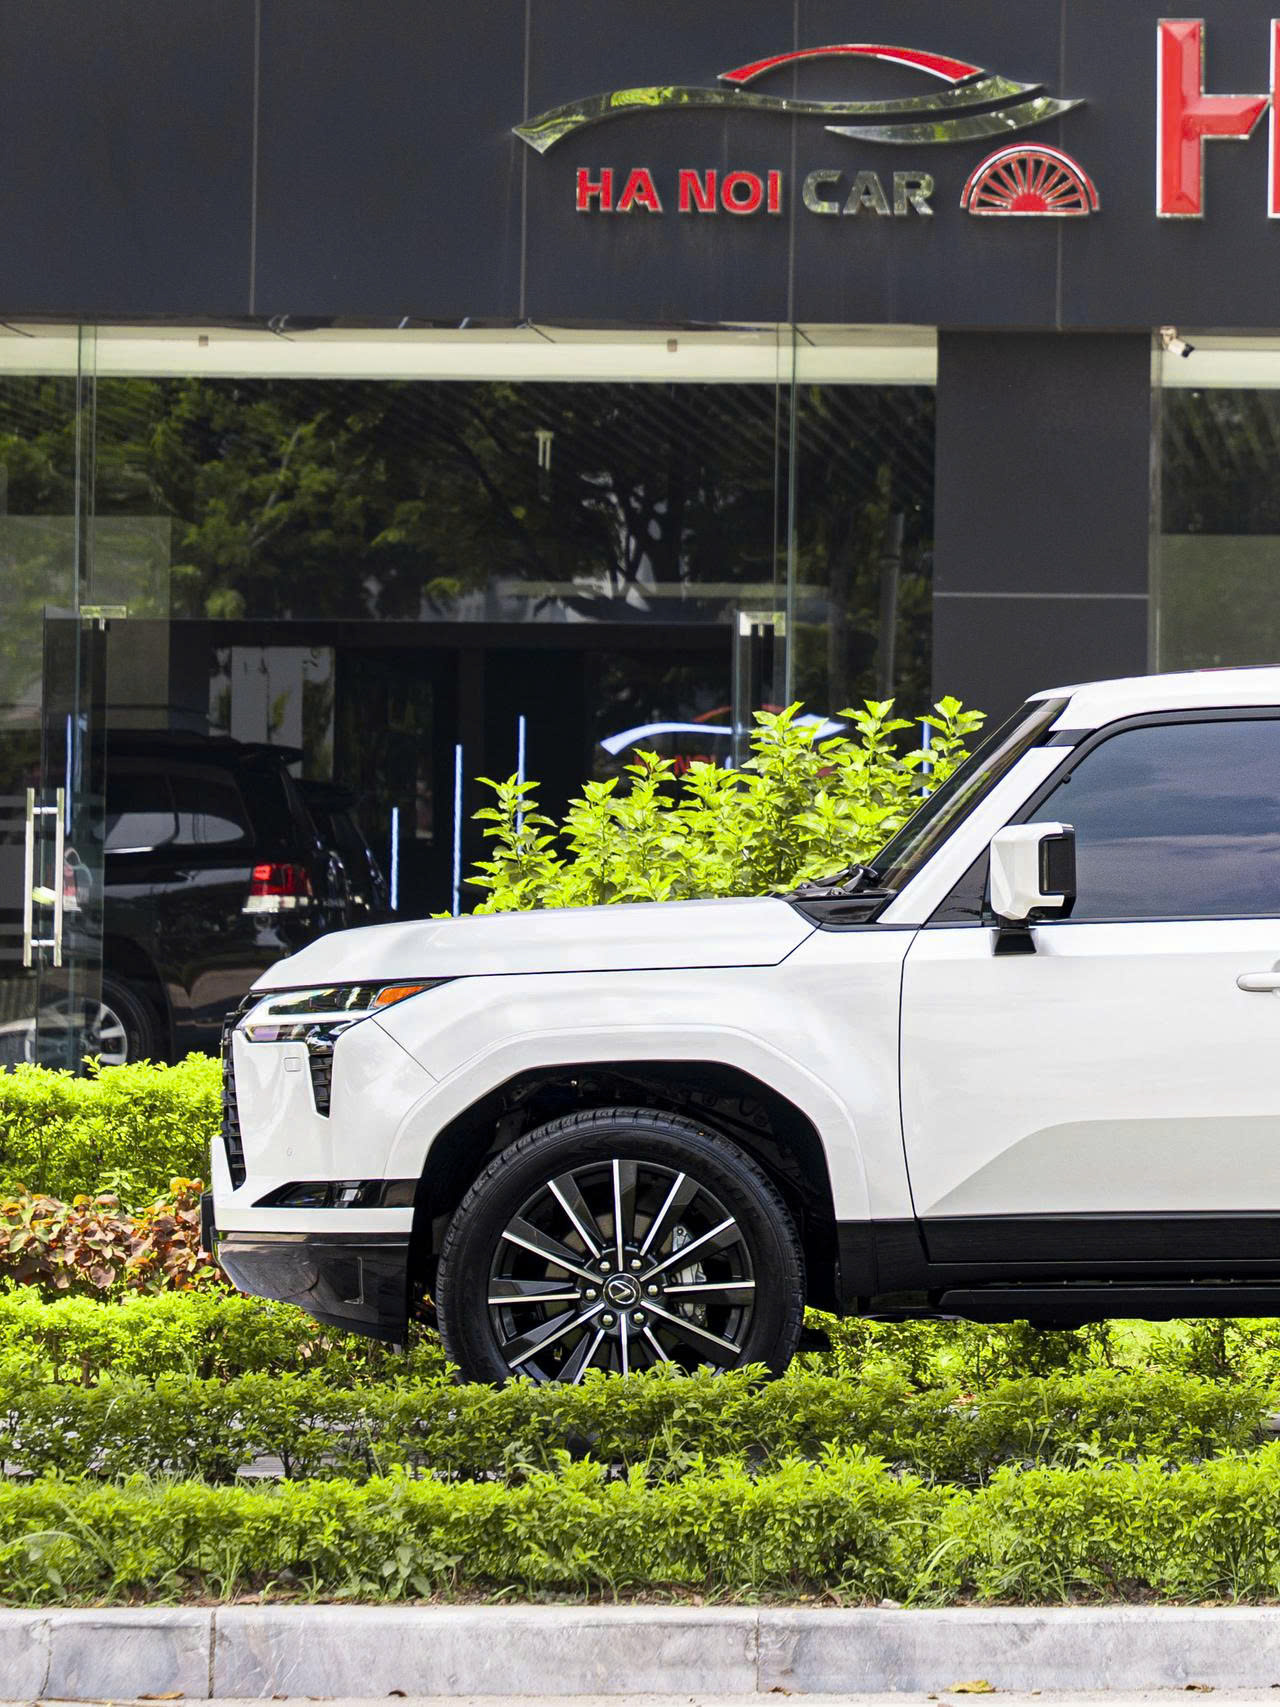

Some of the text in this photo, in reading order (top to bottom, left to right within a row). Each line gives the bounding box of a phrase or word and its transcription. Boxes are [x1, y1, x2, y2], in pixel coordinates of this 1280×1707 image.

[575, 167, 935, 216] HA NOI CAR
